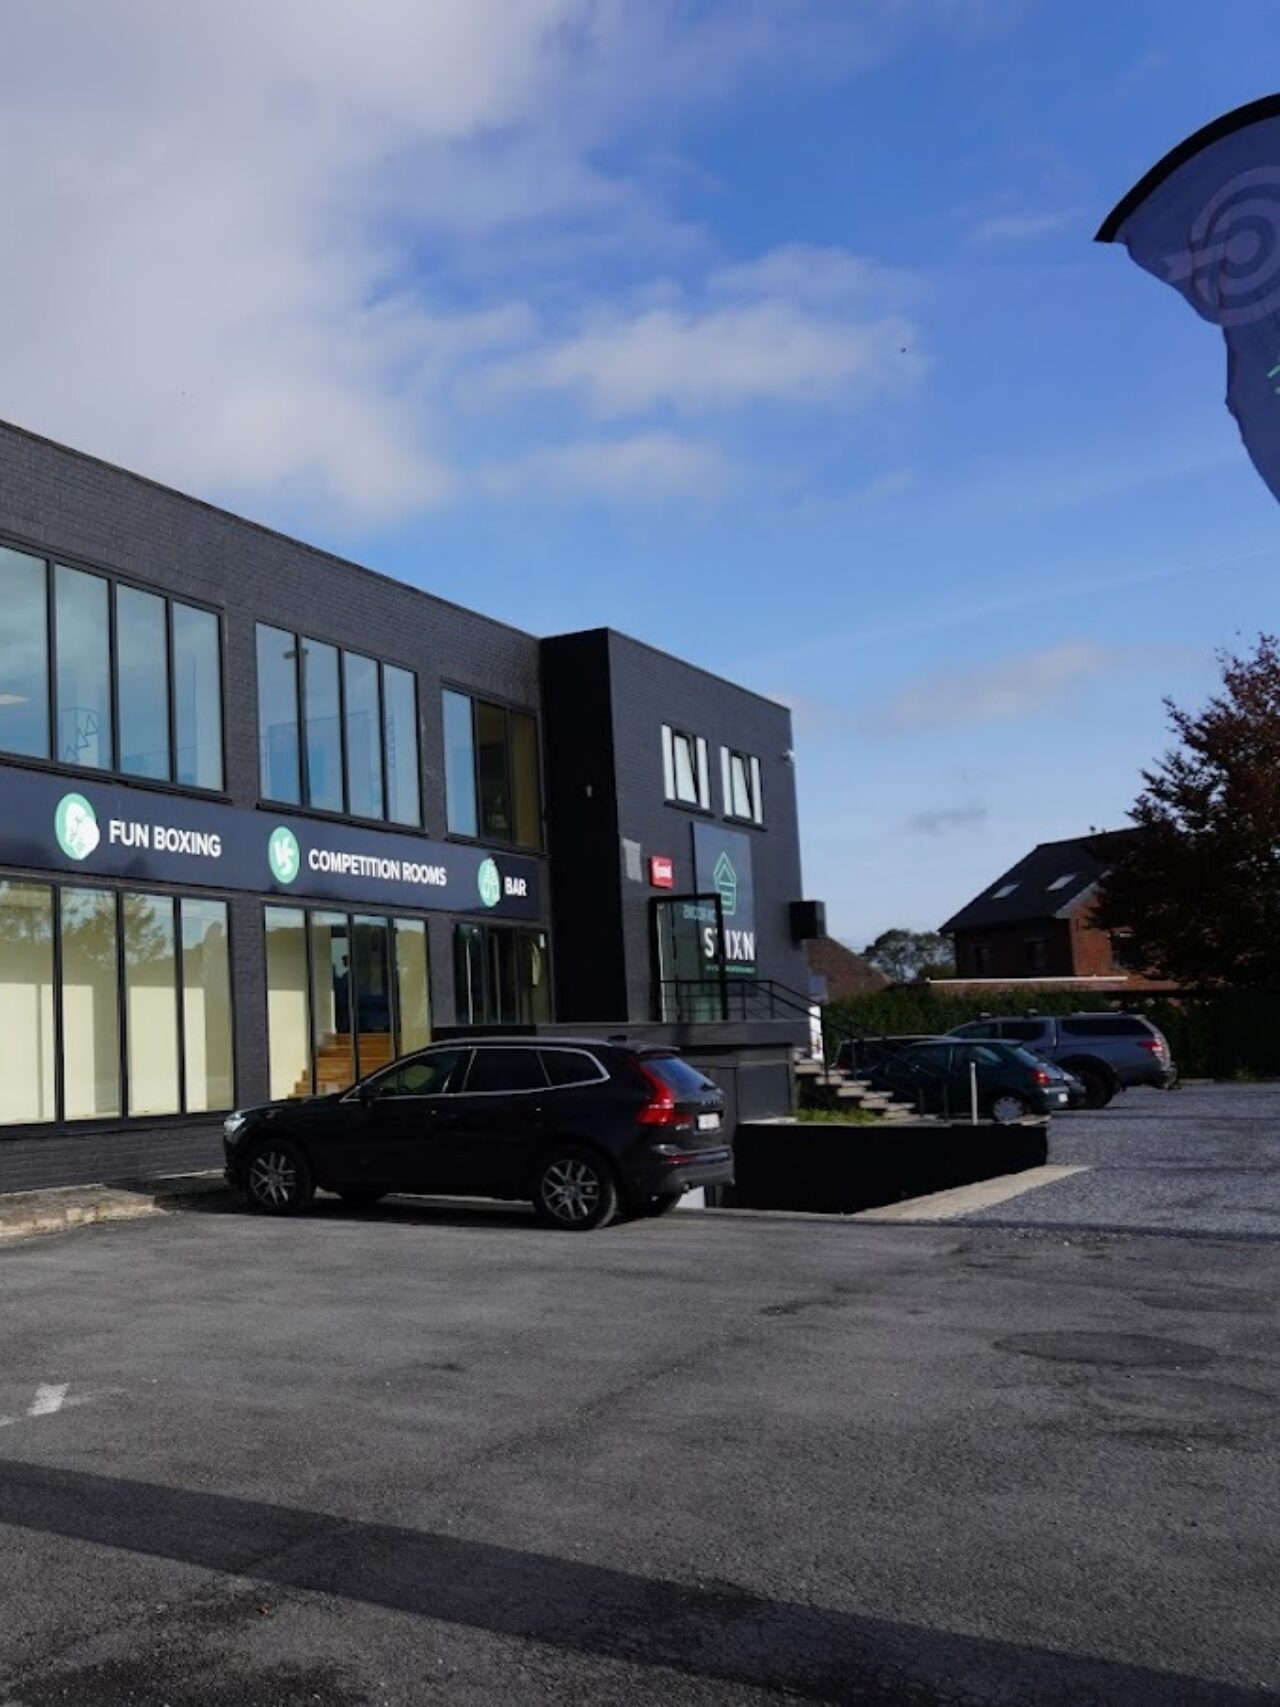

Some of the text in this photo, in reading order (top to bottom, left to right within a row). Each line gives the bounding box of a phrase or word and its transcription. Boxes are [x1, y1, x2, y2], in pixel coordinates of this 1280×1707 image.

[108, 818, 222, 858] FUN BOXING
[308, 848, 448, 887] COMPETITION ROOMS
[504, 876, 528, 897] BAR
[703, 926, 756, 962] SIXN
